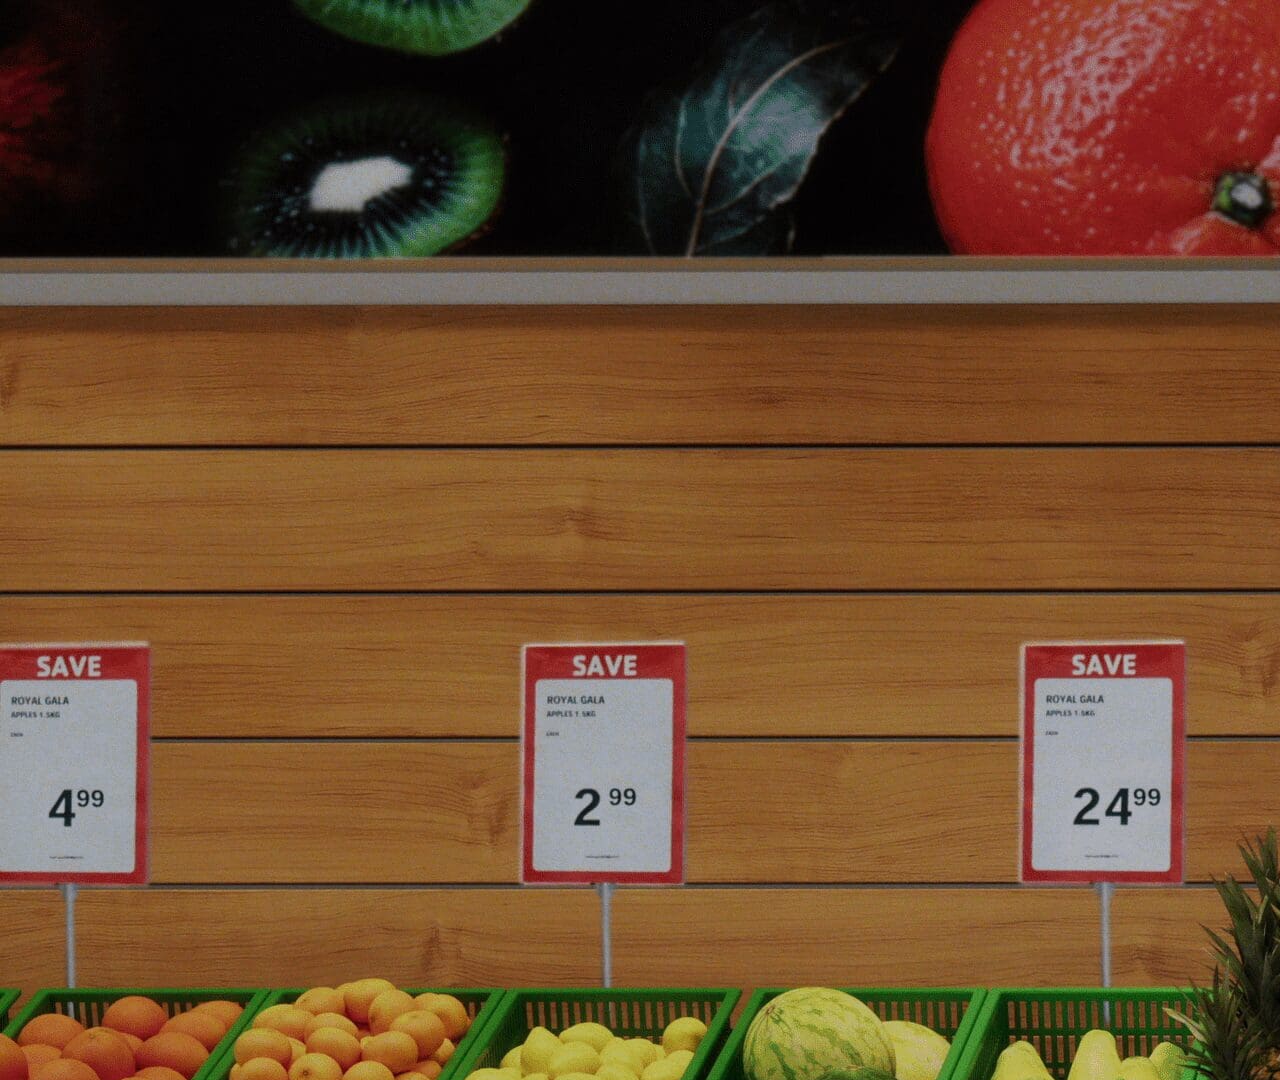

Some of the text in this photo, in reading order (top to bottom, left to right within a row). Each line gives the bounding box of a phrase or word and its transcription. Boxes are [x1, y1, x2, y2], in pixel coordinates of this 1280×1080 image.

[37, 656, 102, 677] SAVE
[572, 655, 637, 676] SAVE
[1072, 654, 1137, 675] SAVE
[11, 696, 69, 705] ROYAL GALA
[547, 696, 605, 705] ROYAL GALA
[1046, 695, 1104, 704] ROYAL GALA
